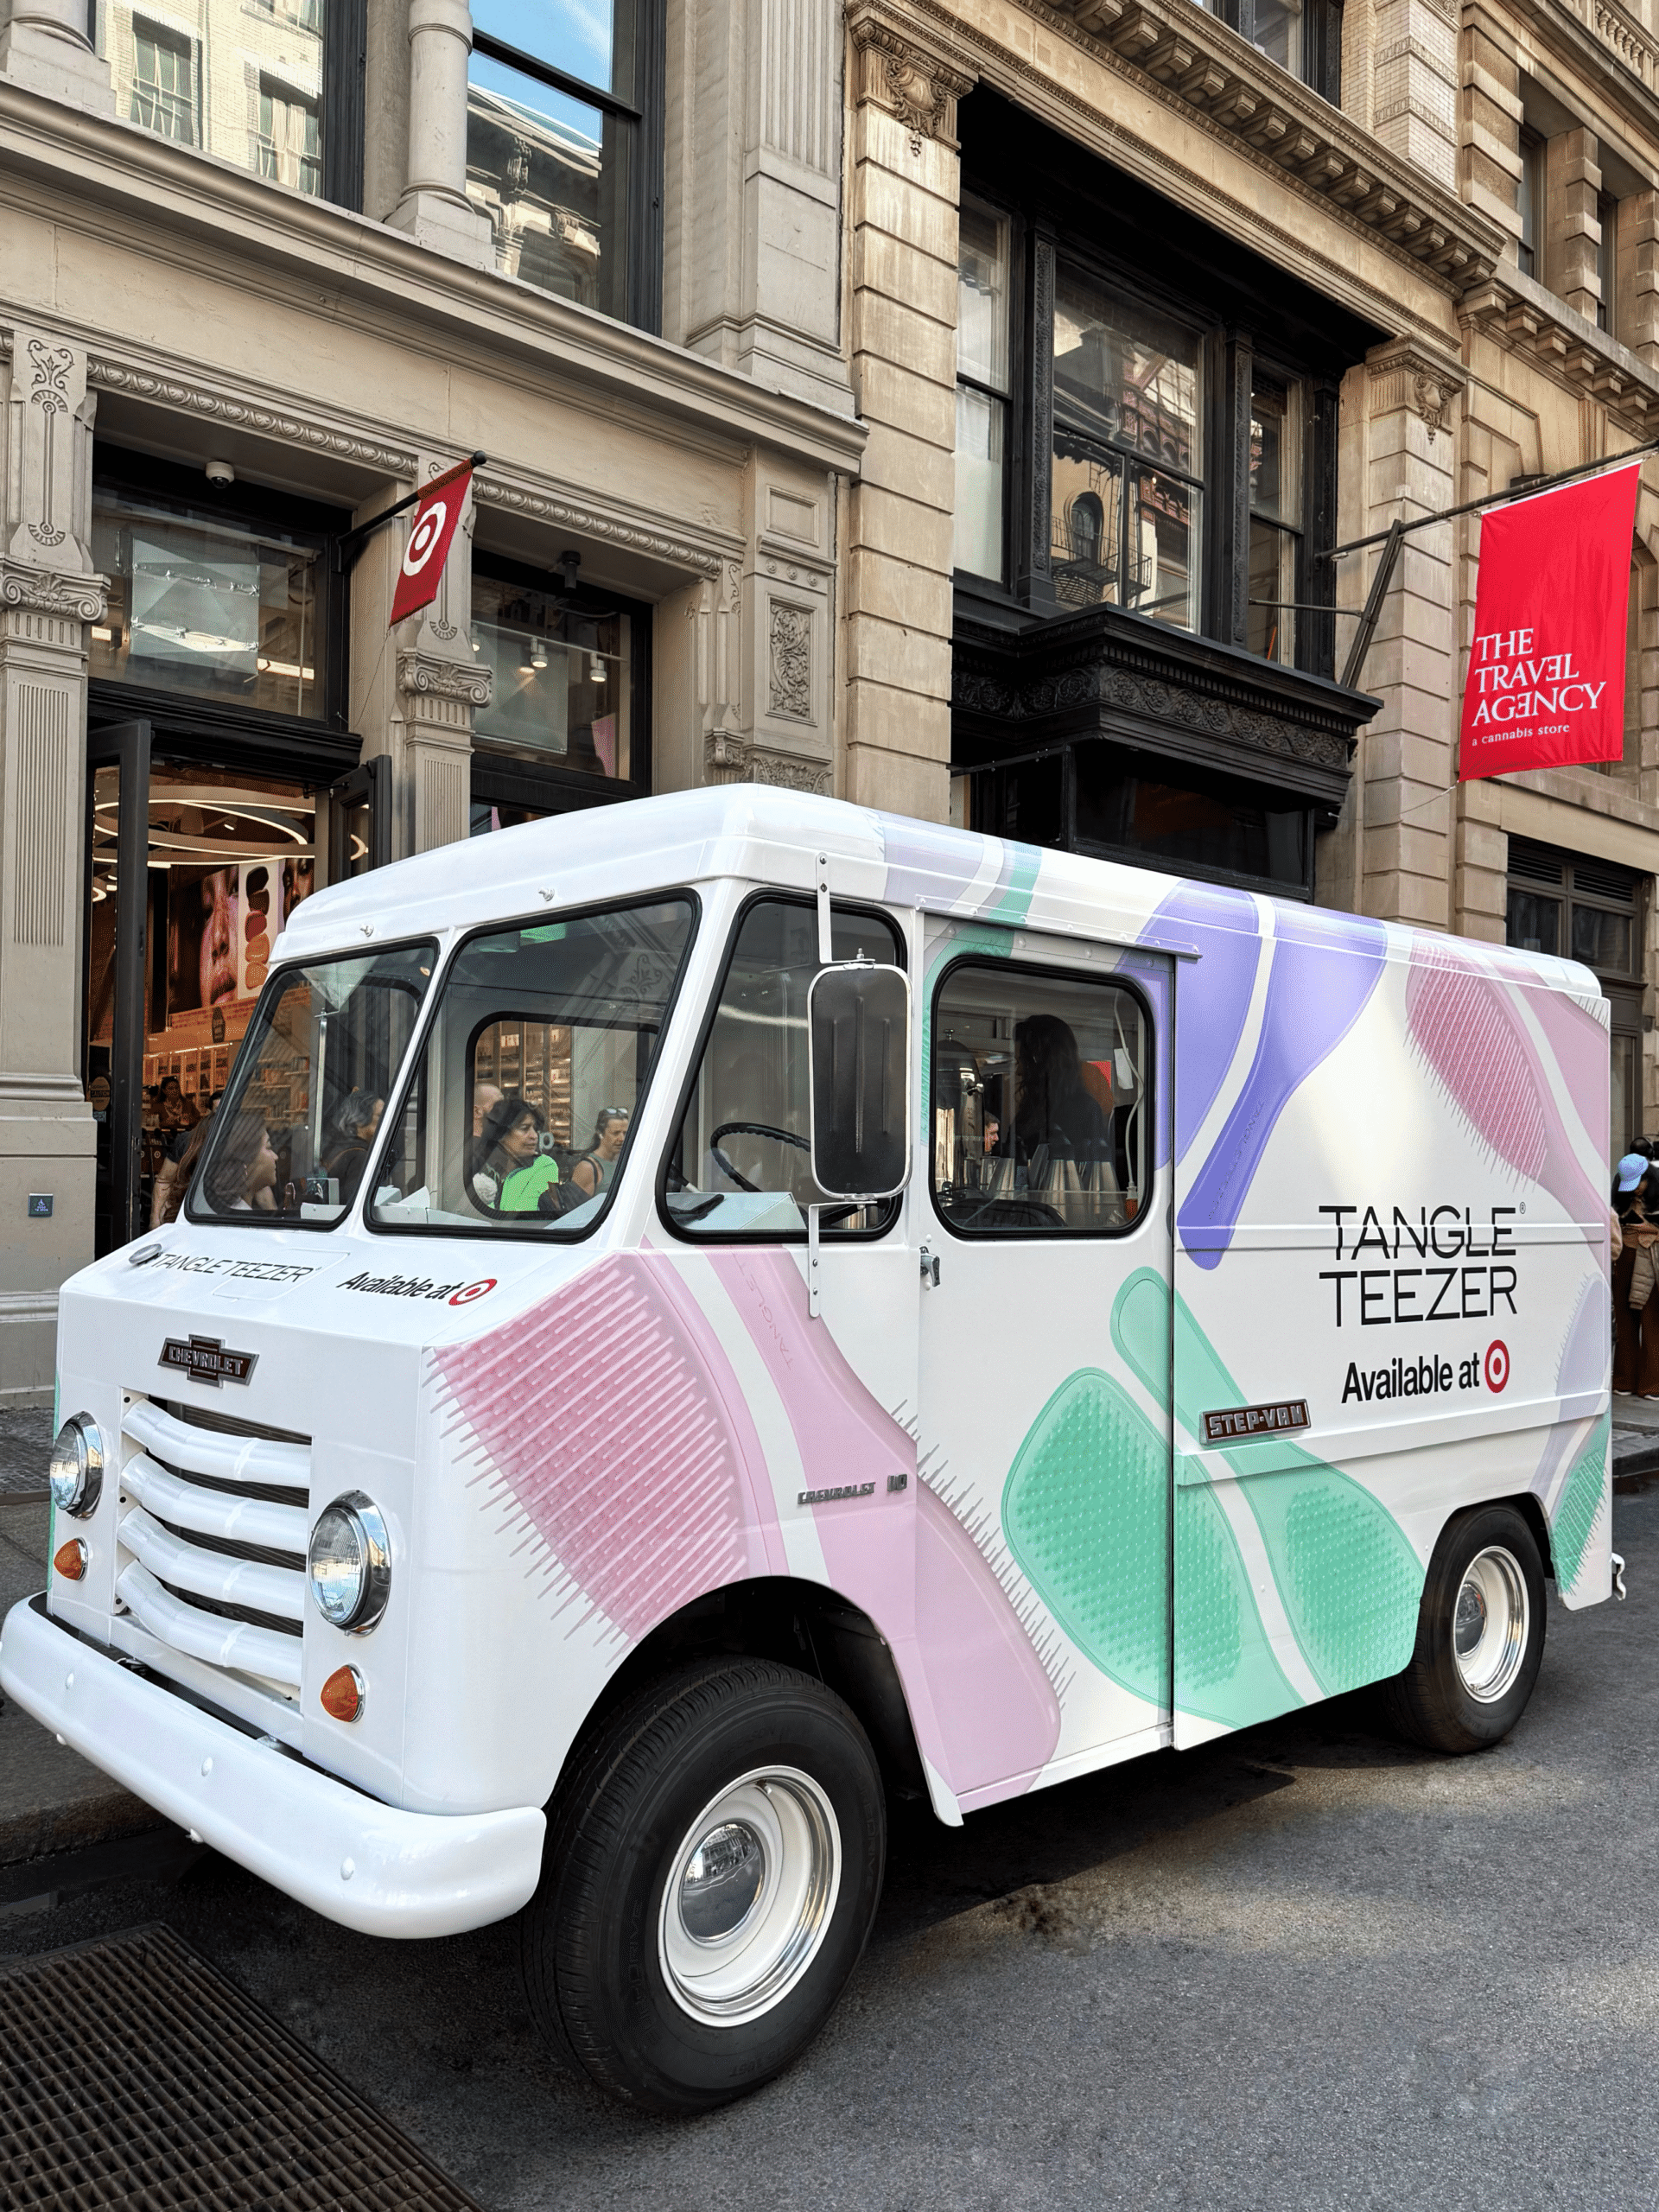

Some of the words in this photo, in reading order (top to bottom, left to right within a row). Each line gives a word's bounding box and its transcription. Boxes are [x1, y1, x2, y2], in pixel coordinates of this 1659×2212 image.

[1476, 628, 1534, 662] THE
[1471, 681, 1606, 727] AGENCY
[1471, 737, 1478, 747] a
[1481, 726, 1533, 745] cannabis
[1538, 724, 1570, 736] store
[151, 1254, 233, 1274] TANGLE
[222, 1262, 315, 1283] TEEZER
[335, 1271, 434, 1297] Available
[424, 1281, 465, 1300] at
[1319, 1266, 1517, 1327] TEEZER
[168, 1345, 244, 1375] CHEVROLET
[1341, 1354, 1452, 1403] Available
[1459, 1352, 1480, 1389] at
[1210, 1405, 1305, 1436] STEP-VAN
[798, 1482, 876, 1505] CHEVROLET
